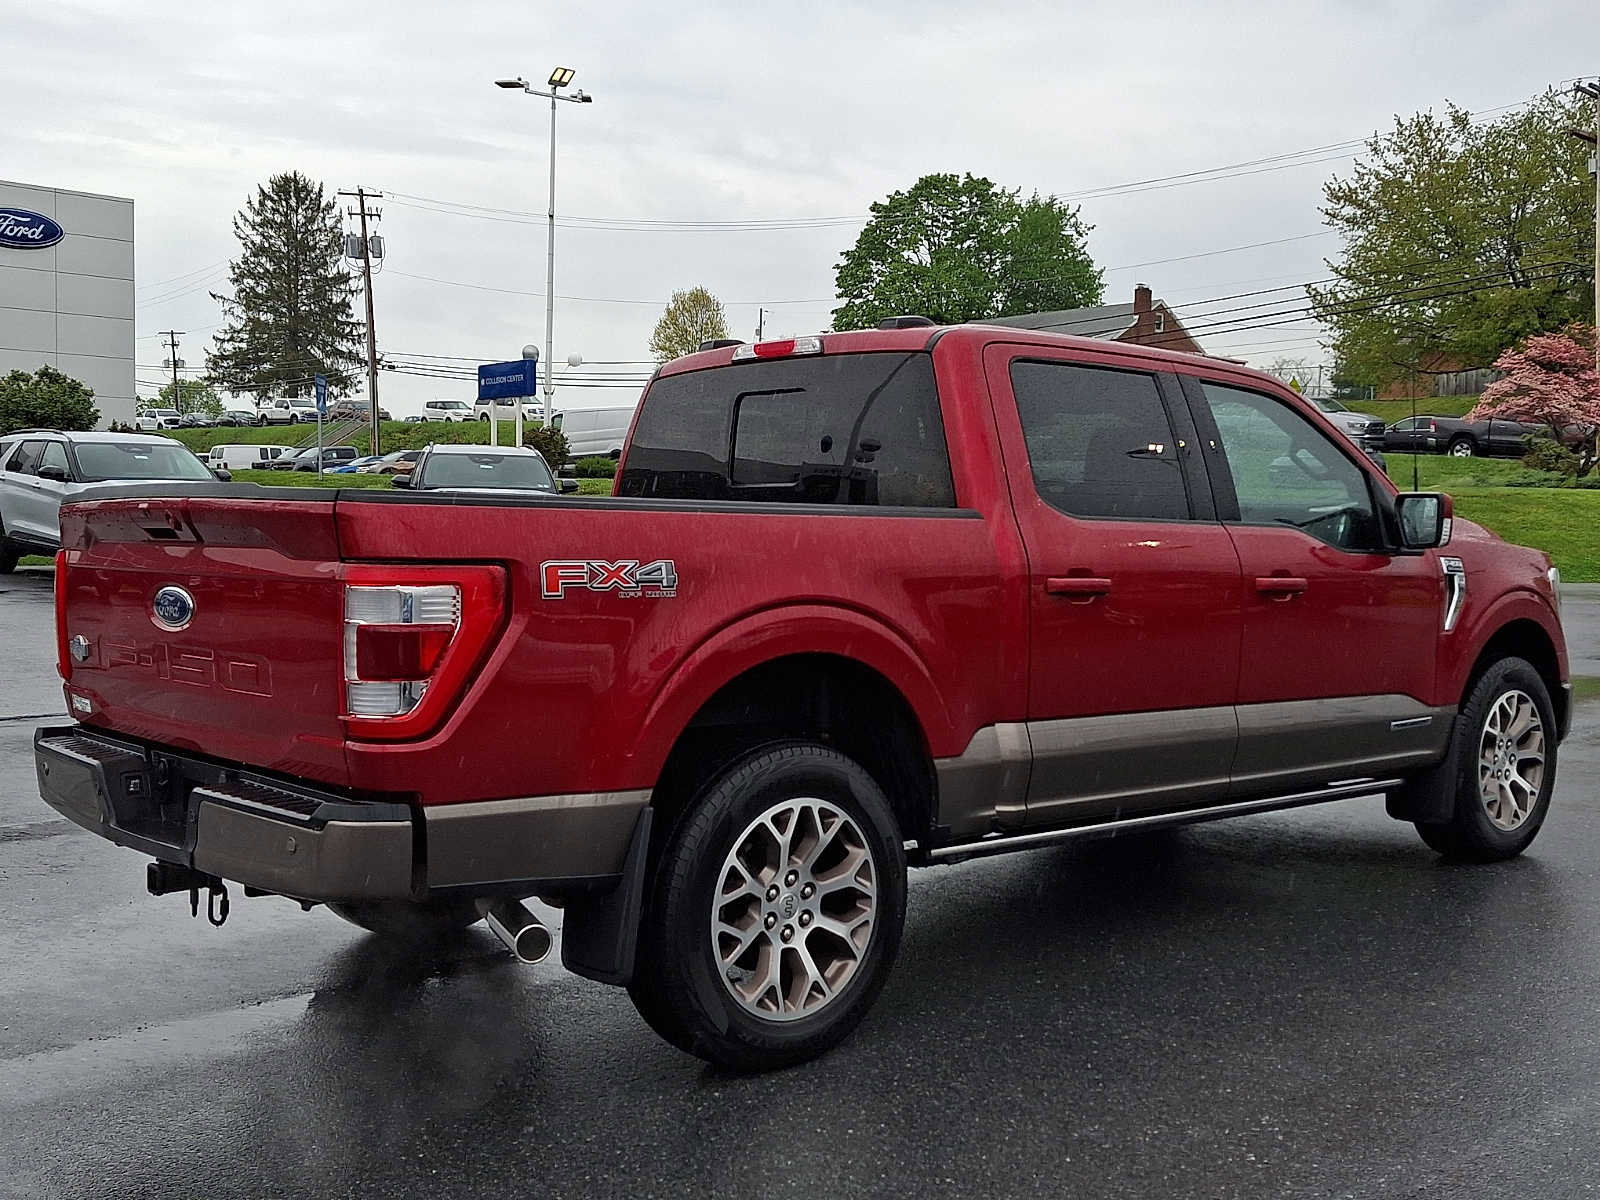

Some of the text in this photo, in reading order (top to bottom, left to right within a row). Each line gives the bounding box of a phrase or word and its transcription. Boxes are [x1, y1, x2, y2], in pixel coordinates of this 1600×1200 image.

[0, 213, 45, 239] Ford
[486, 374, 524, 385] COLLISION CENTER
[540, 560, 678, 599] FX4
[97, 634, 273, 698] F-150
